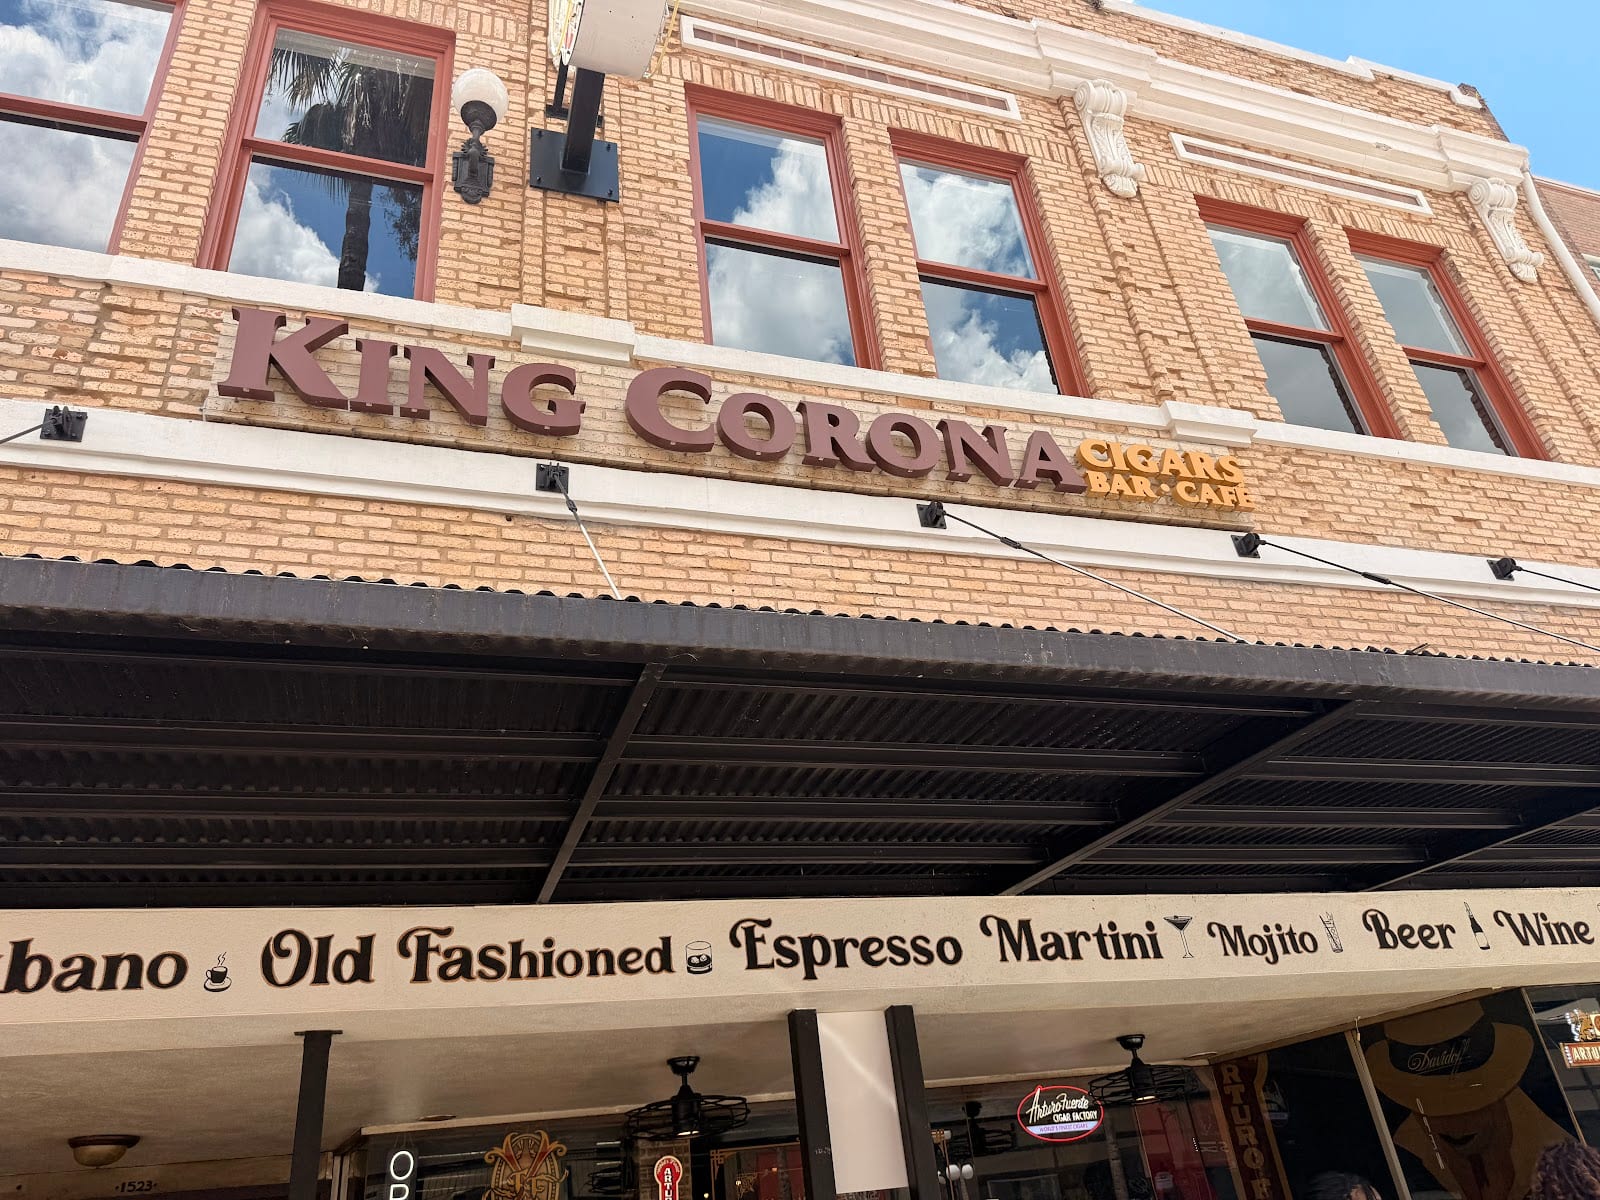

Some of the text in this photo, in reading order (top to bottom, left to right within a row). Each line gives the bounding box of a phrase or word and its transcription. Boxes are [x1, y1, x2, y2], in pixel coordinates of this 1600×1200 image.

[217, 306, 1088, 494] KING CORONA
[1076, 438, 1244, 487] CIGARS
[1085, 470, 1159, 502] BAR
[728, 914, 1164, 981] Espresso Martini
[1206, 920, 1320, 965] Mojito
[1362, 908, 1456, 950] Beer
[1493, 909, 1596, 946] Wine
[0, 937, 189, 995] bano
[260, 925, 676, 988] Old Fashioned
[1052, 1110, 1098, 1123] CIGAR FACTORY
